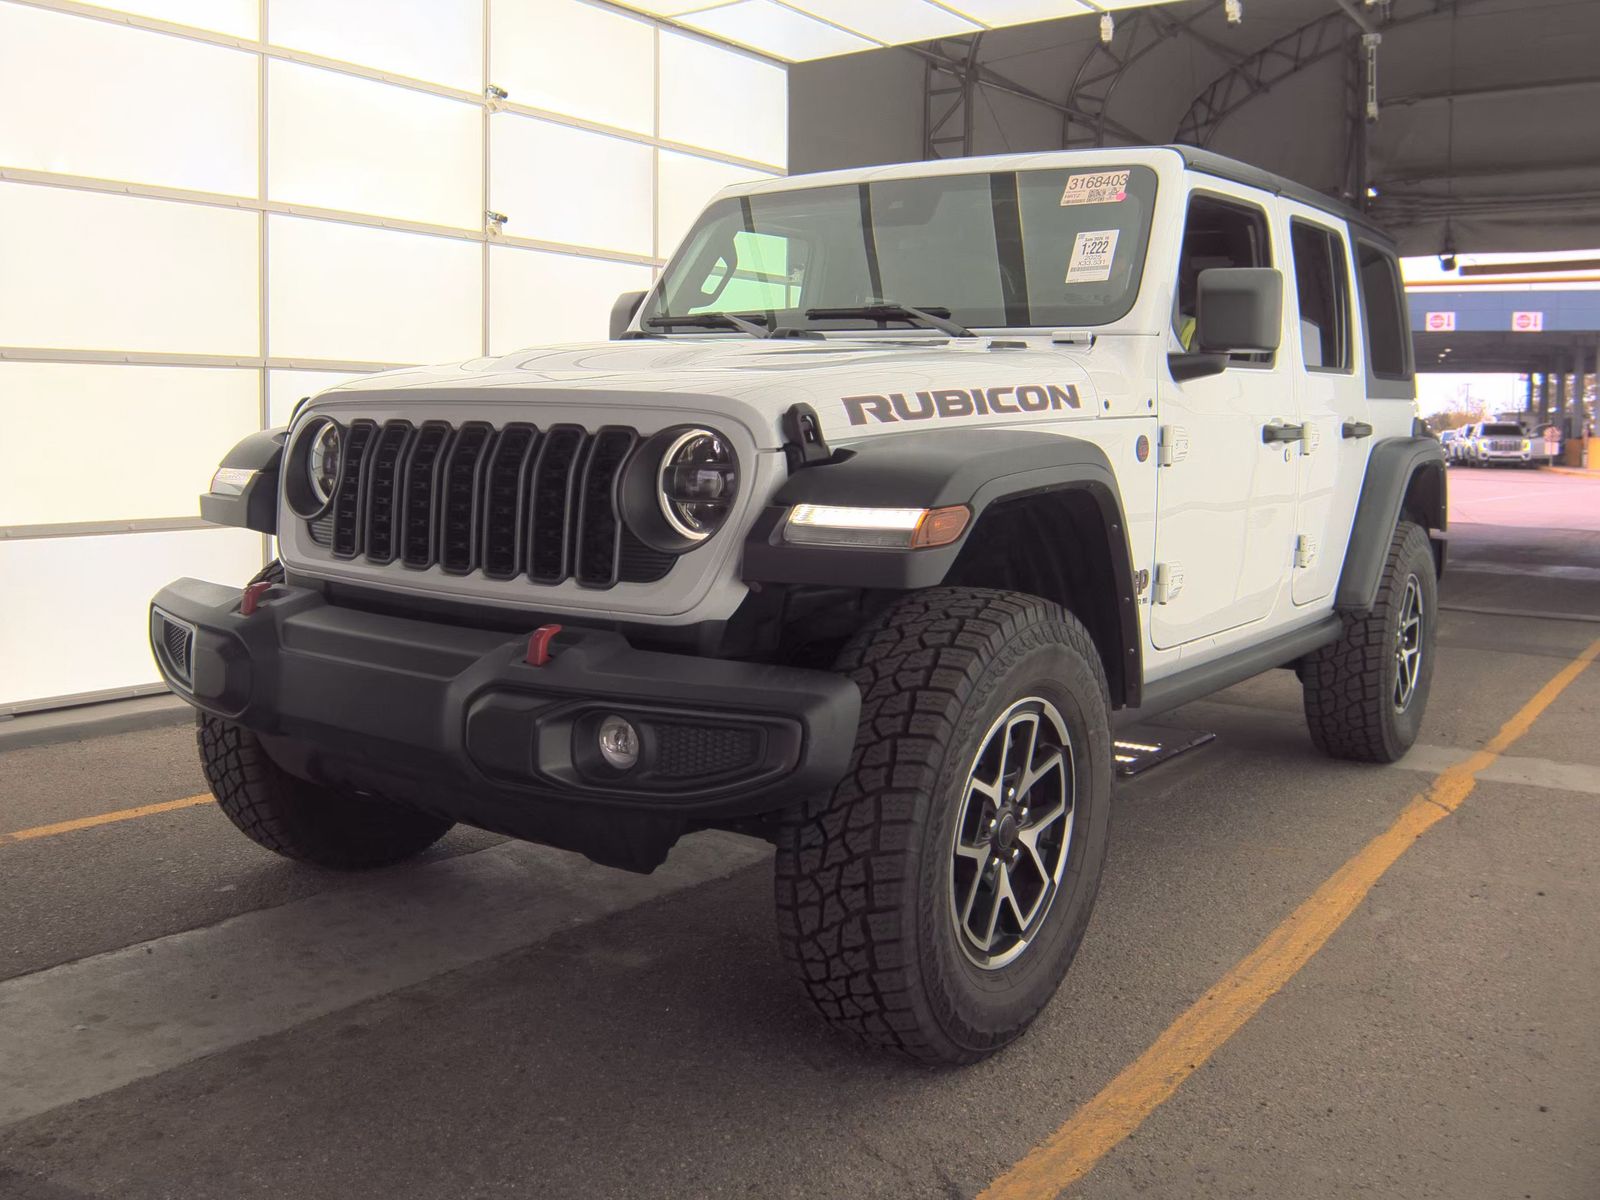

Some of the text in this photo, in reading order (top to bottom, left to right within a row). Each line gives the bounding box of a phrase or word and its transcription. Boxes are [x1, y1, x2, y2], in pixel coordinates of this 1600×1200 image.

[1069, 174, 1129, 190] 3168403
[1082, 240, 1109, 255] 1:222
[841, 384, 1080, 426] RUBICON
